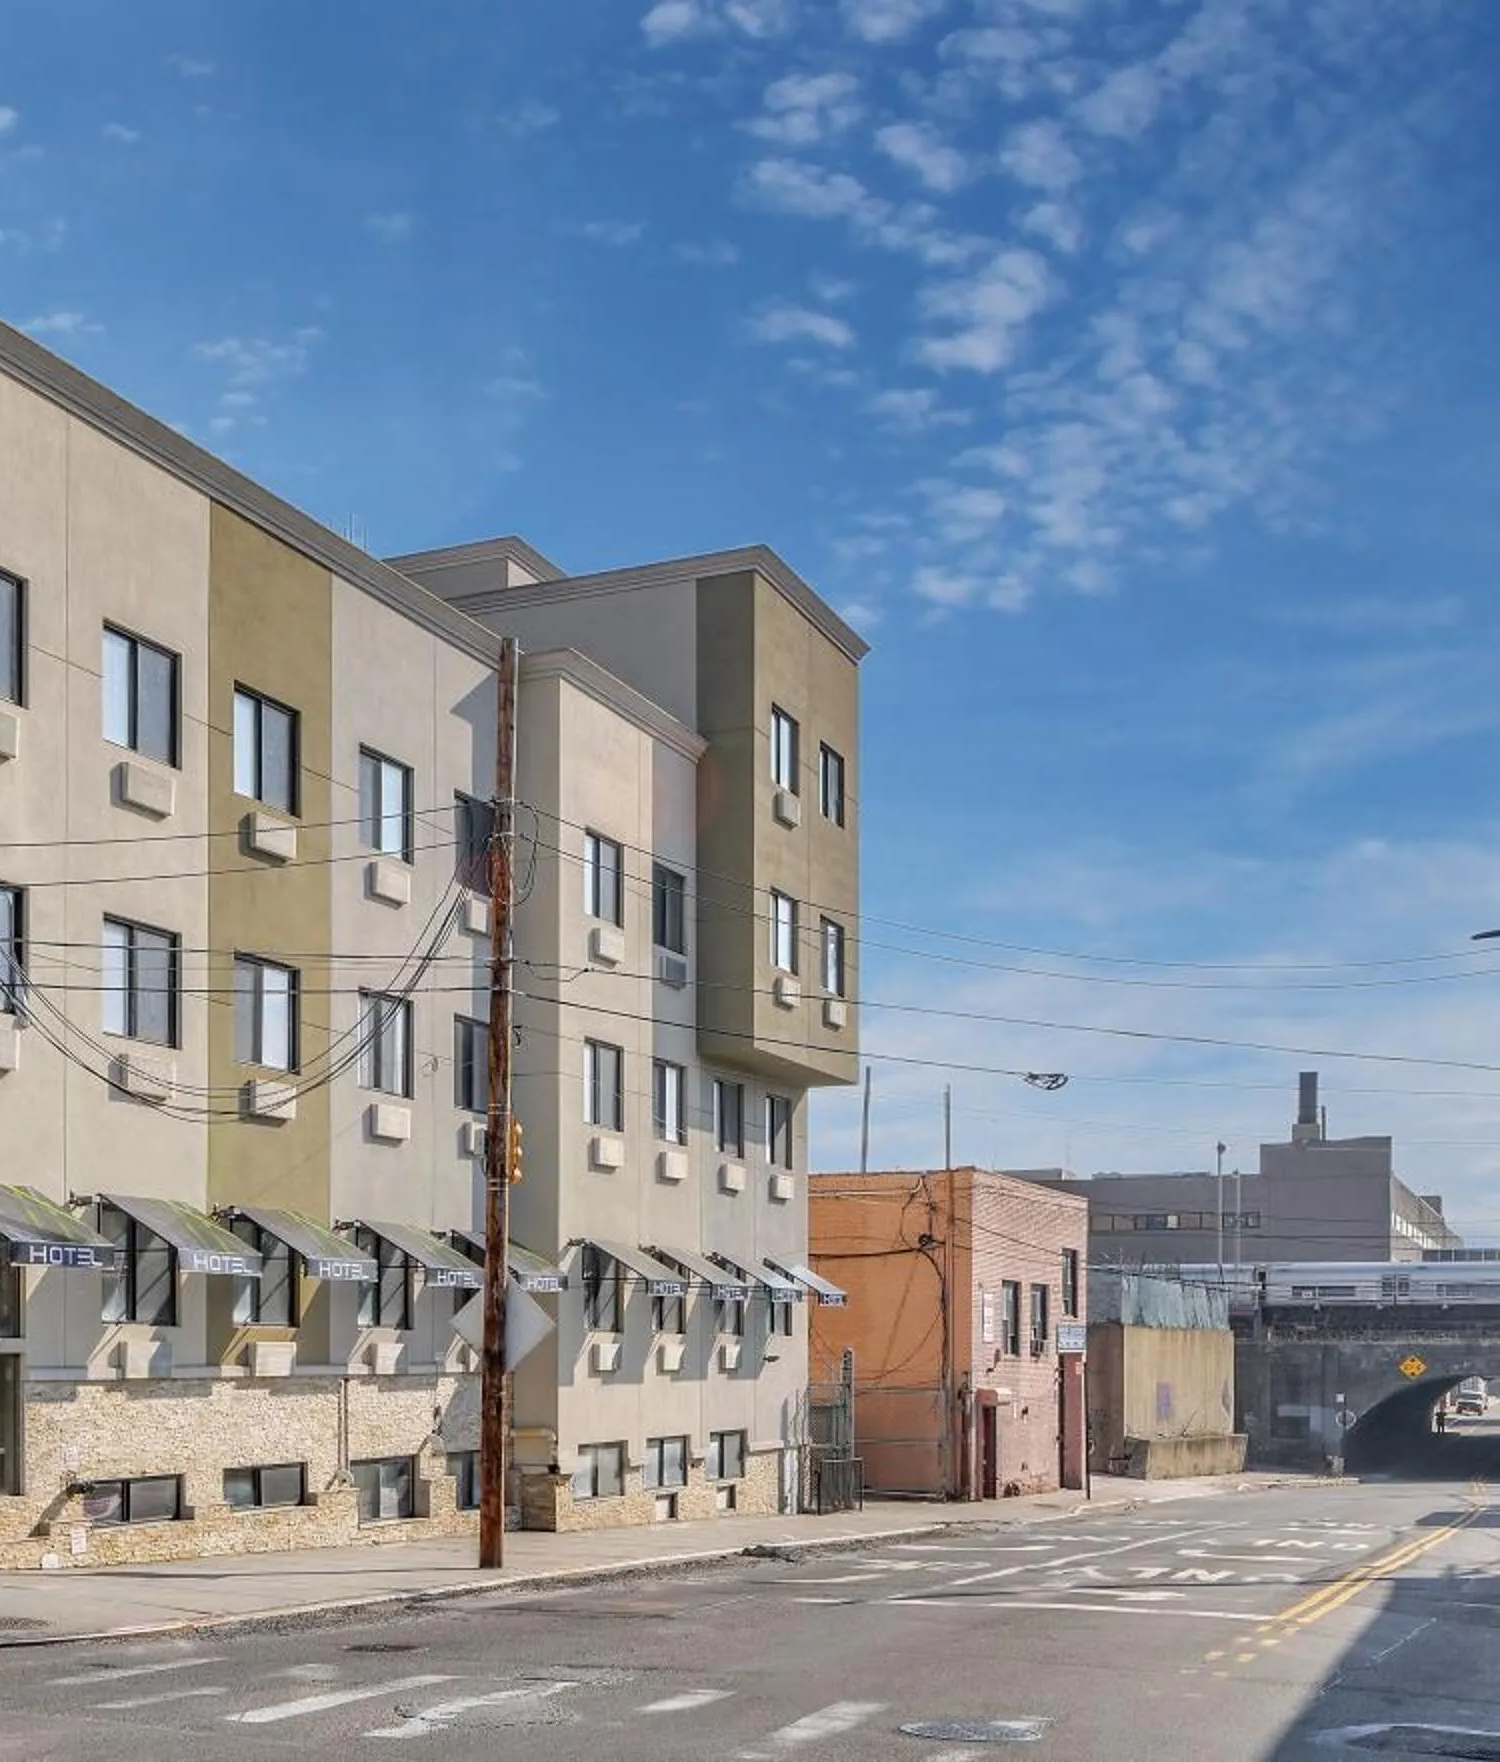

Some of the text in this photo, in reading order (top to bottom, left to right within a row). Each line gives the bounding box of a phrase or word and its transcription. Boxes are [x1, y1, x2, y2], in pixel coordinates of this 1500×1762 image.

[29, 1245, 103, 1267] HOTEL
[193, 1255, 253, 1274] HOTEL
[319, 1261, 369, 1280] HOTEL
[436, 1270, 479, 1287] HOTEL
[527, 1275, 563, 1292] HOTEL
